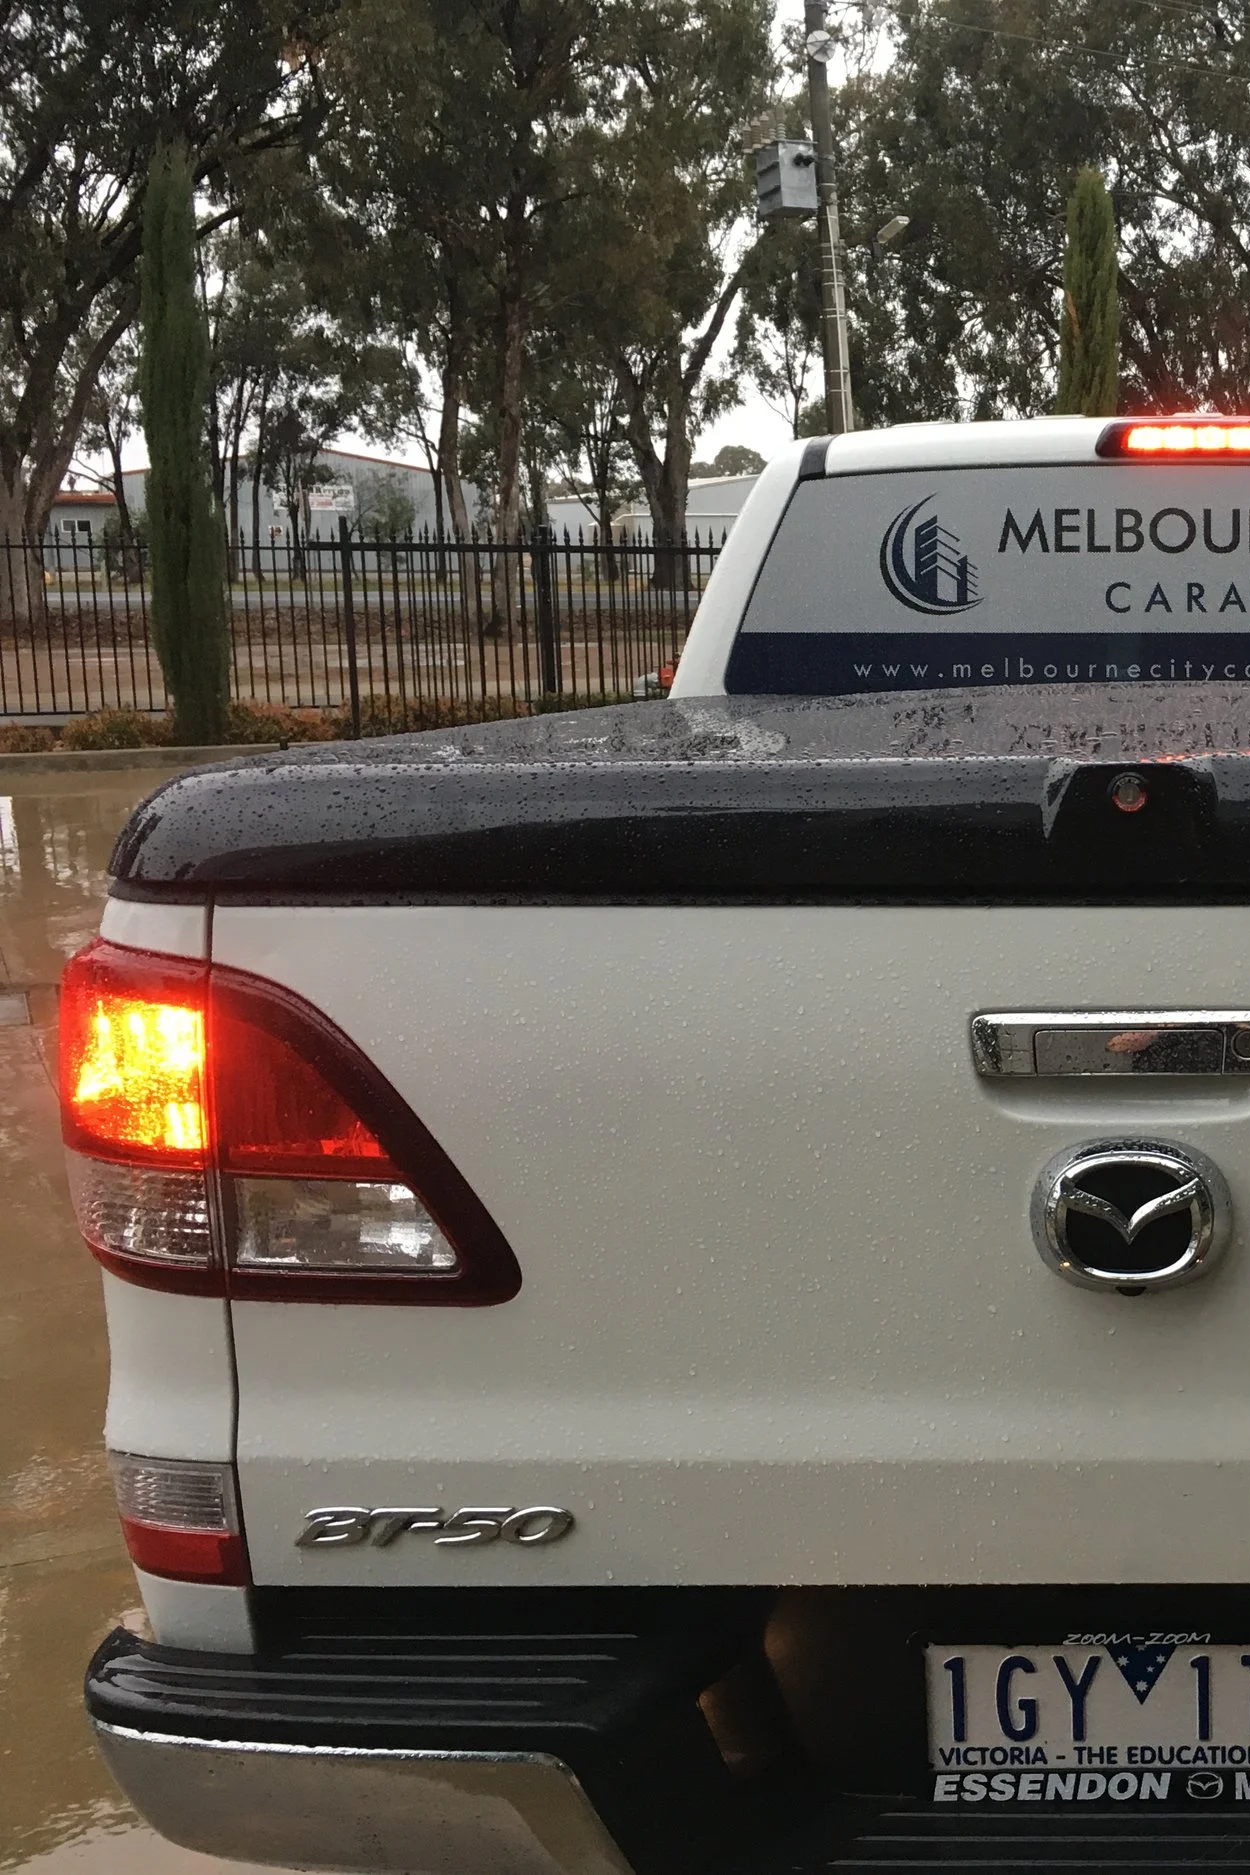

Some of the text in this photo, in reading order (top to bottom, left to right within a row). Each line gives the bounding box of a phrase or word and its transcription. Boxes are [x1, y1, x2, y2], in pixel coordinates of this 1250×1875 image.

[294, 1505, 575, 1548] BT-50
[943, 1654, 1102, 1743] 1GY
[939, 1746, 1049, 1766] VICTORIA
[1072, 1746, 1119, 1766] THE
[933, 1772, 1172, 1802] ESSENDON
